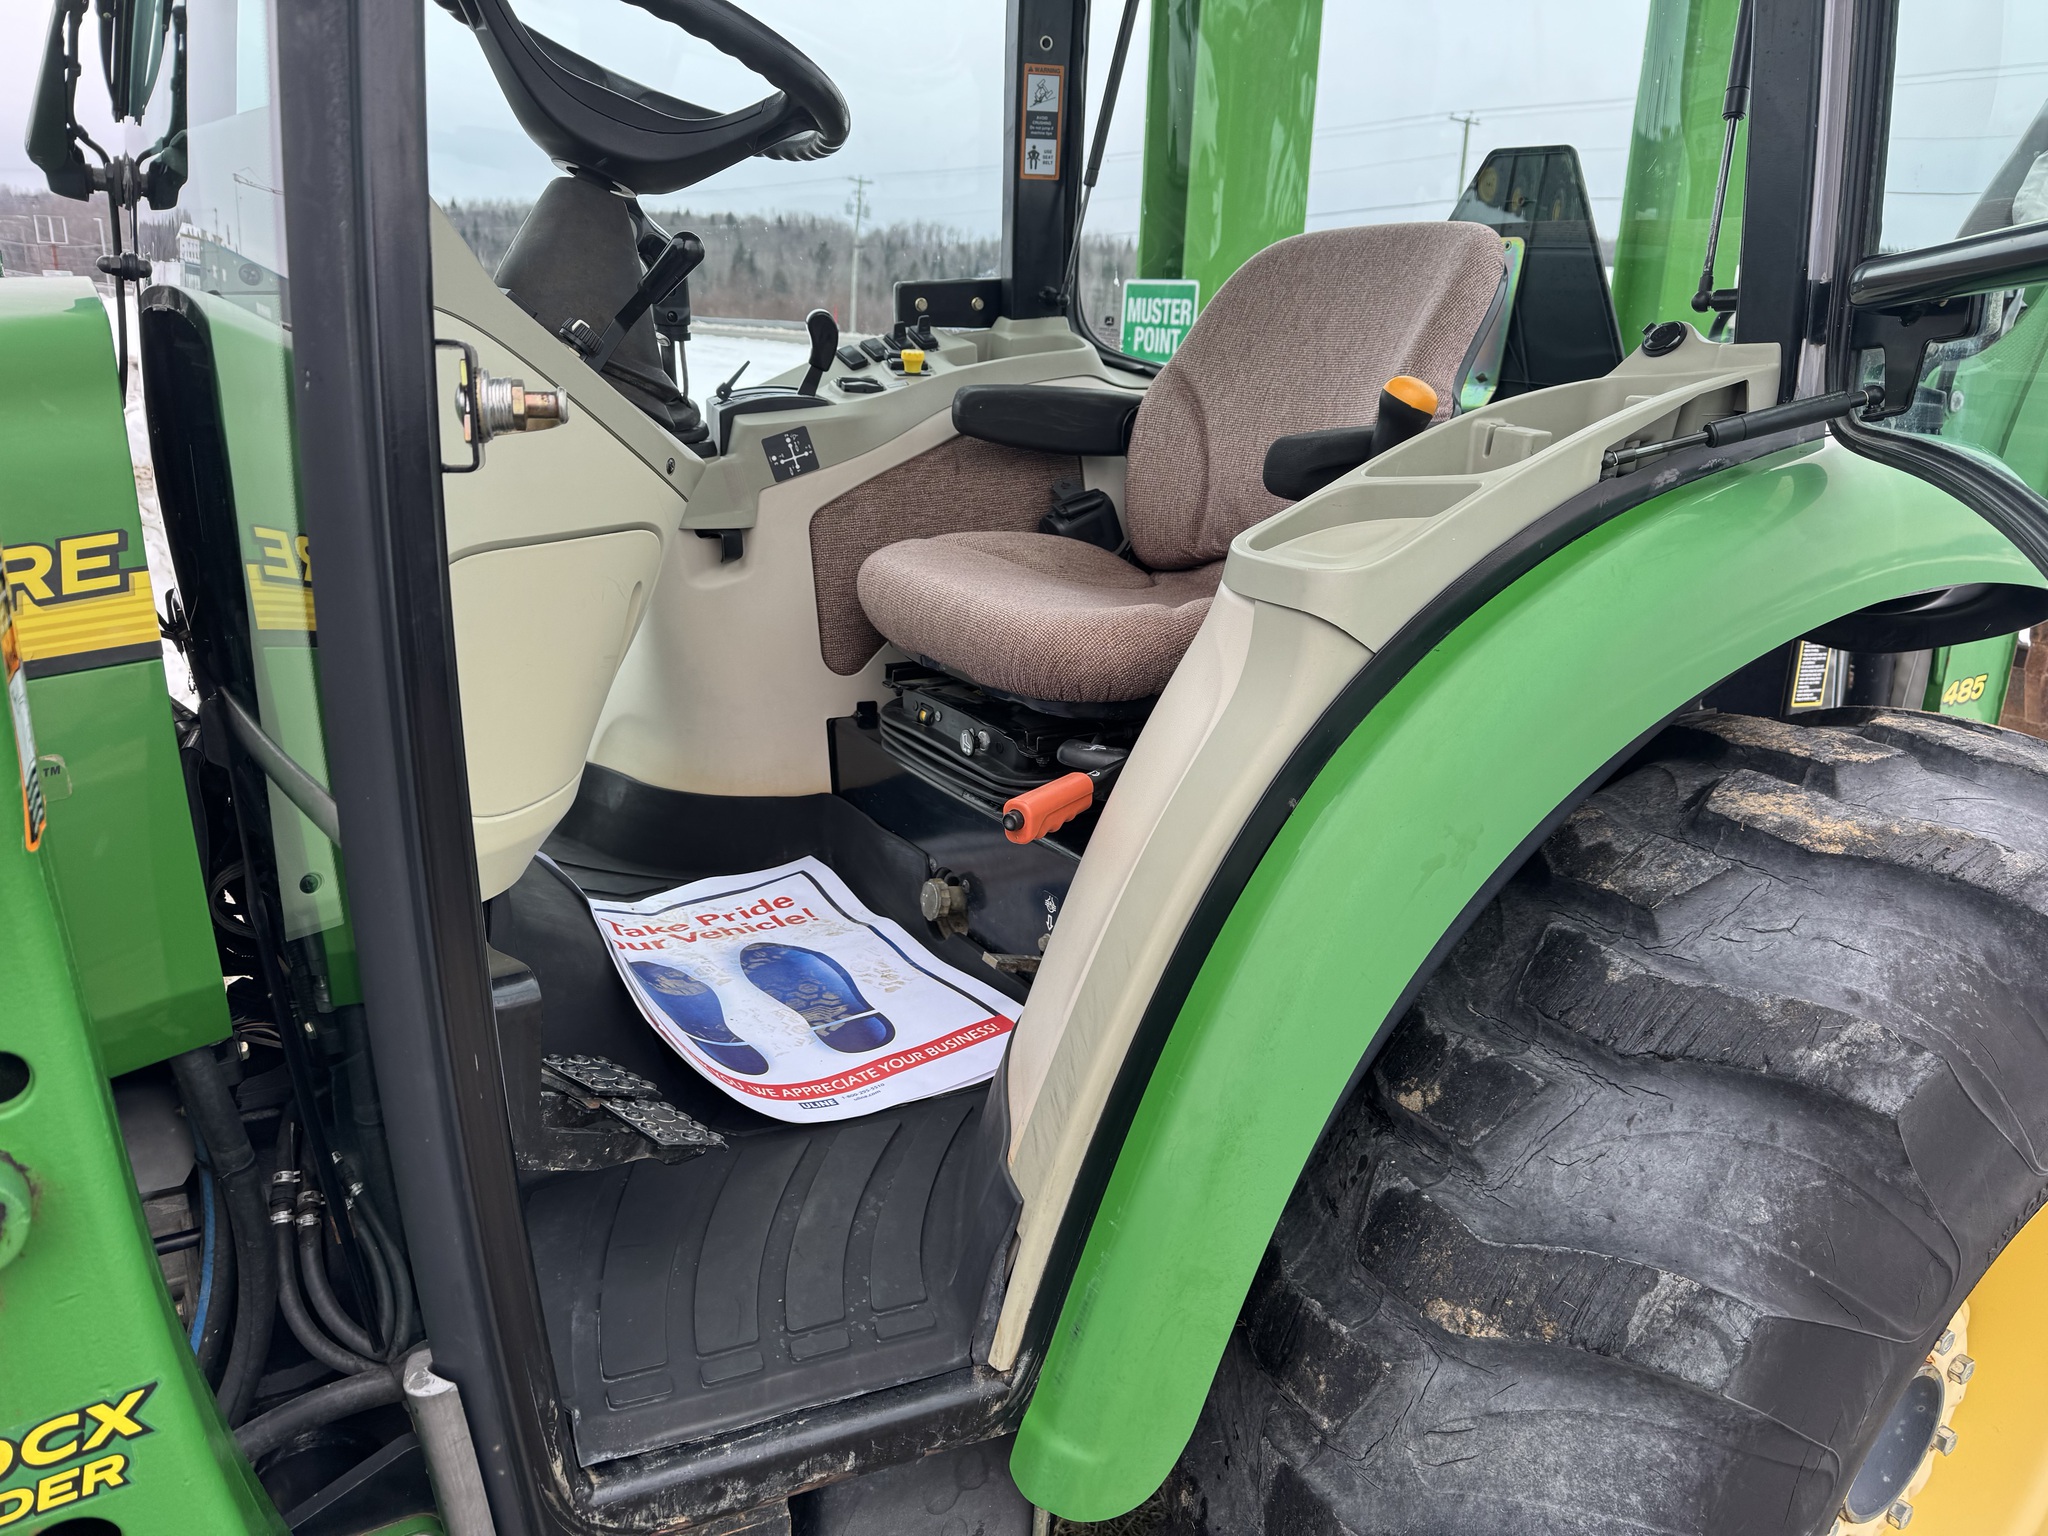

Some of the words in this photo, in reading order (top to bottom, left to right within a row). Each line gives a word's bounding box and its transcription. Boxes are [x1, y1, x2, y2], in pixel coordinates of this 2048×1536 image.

[1127, 297, 1192, 326] MUSTER
[1133, 326, 1181, 355] POINT
[1942, 673, 1988, 705] 485
[43, 765, 60, 777] TM
[601, 917, 691, 939] Take
[695, 896, 795, 927] Pride
[668, 907, 820, 943] Vehicle!
[749, 1085, 780, 1098] WE
[783, 1067, 881, 1098] APPRECIATE
[878, 1052, 926, 1073] YOUR
[924, 1023, 1000, 1057] BUSINESS!
[800, 1099, 838, 1110] ULINE
